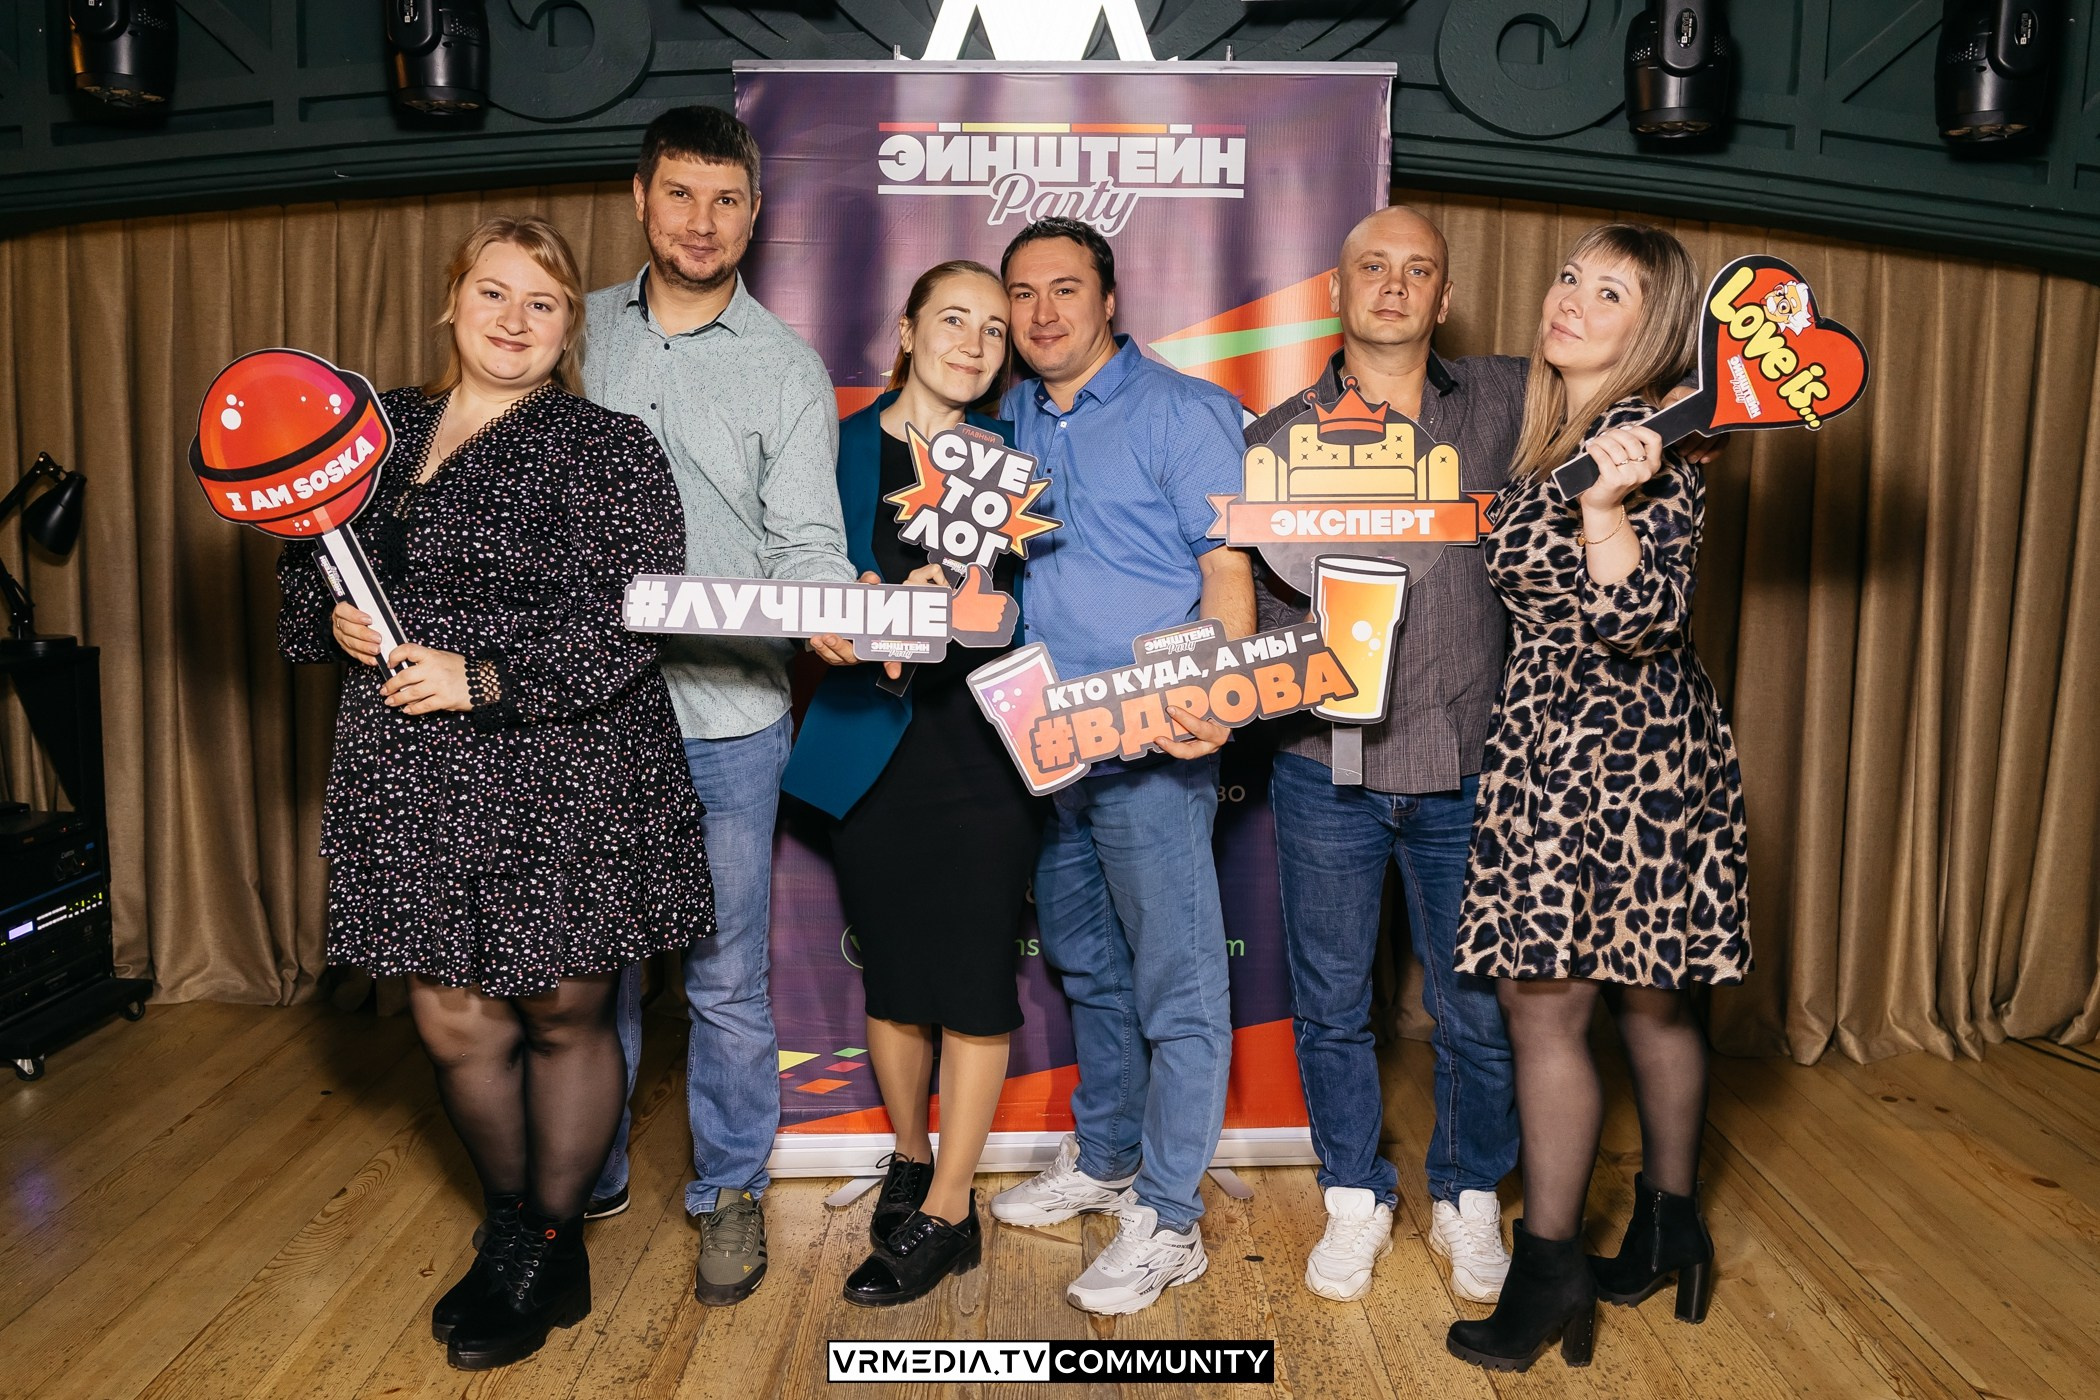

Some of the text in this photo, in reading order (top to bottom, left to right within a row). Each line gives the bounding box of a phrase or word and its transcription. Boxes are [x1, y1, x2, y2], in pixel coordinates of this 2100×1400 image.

[878, 124, 1246, 184] ЭЙНШТЕЙН
[987, 170, 1141, 237] Party
[1709, 266, 1798, 380] Love
[931, 433, 1034, 495] СУЕ
[962, 427, 996, 444] ГЛАВНЫЙ
[225, 435, 376, 511] I AM SOSKA
[940, 474, 1008, 528] ТО
[902, 508, 1009, 567] ЛОГ
[1270, 509, 1435, 536] ЭКСПЕРТ
[626, 580, 948, 637] #ЛУЧШИЕ
[1046, 678, 1107, 711] КТО
[1111, 655, 1209, 696] КУДА,
[1215, 646, 1240, 671] А
[1245, 631, 1298, 664] МЫ
[1031, 650, 1354, 770] #ВДРОВА
